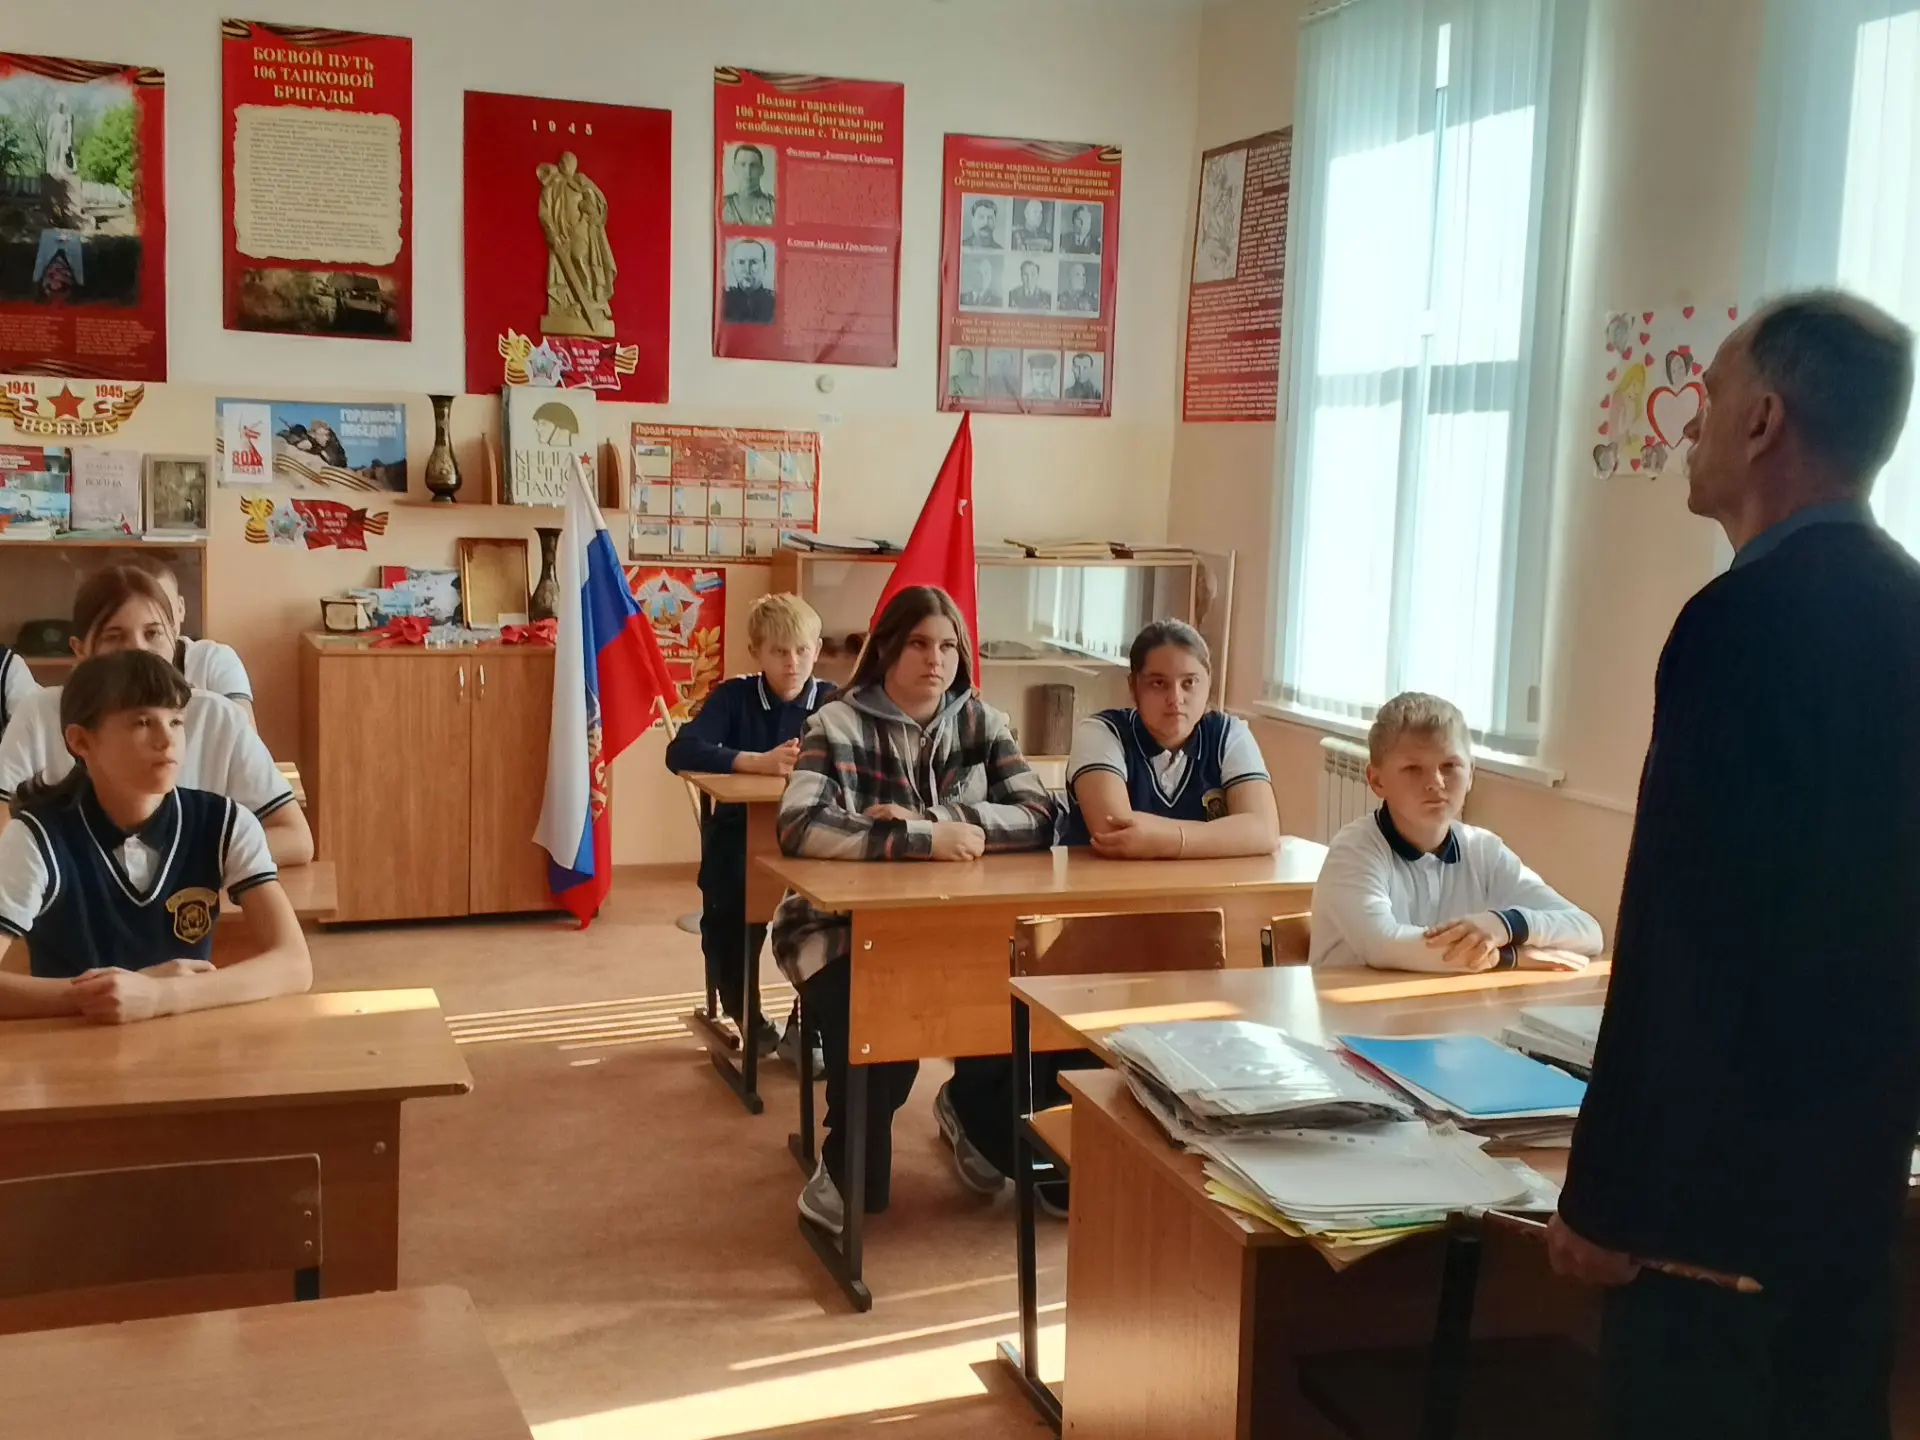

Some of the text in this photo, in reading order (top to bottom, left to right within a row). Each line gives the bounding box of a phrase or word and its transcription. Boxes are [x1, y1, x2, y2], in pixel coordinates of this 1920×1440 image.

[253, 46, 374, 71] БОЕВОЙ ПУТЬ
[253, 64, 374, 89] 106 ТАНКОВОЙ
[273, 84, 355, 105] БРИГАДЫ
[756, 93, 864, 116] Подвиг гвардейцев
[735, 105, 884, 131] 106 танковой бригады при
[735, 120, 815, 137] освобождении
[830, 127, 883, 144] Татарино
[959, 158, 1004, 170] Советские
[1006, 162, 1050, 174] маршалы,
[6, 381, 36, 395] 1941
[95, 385, 123, 399] 1945
[21, 416, 116, 437] ПОБЕДА
[340, 408, 402, 424] ГОРДИМСЯ
[232, 450, 248, 467] 80
[514, 449, 576, 467] КНИГА
